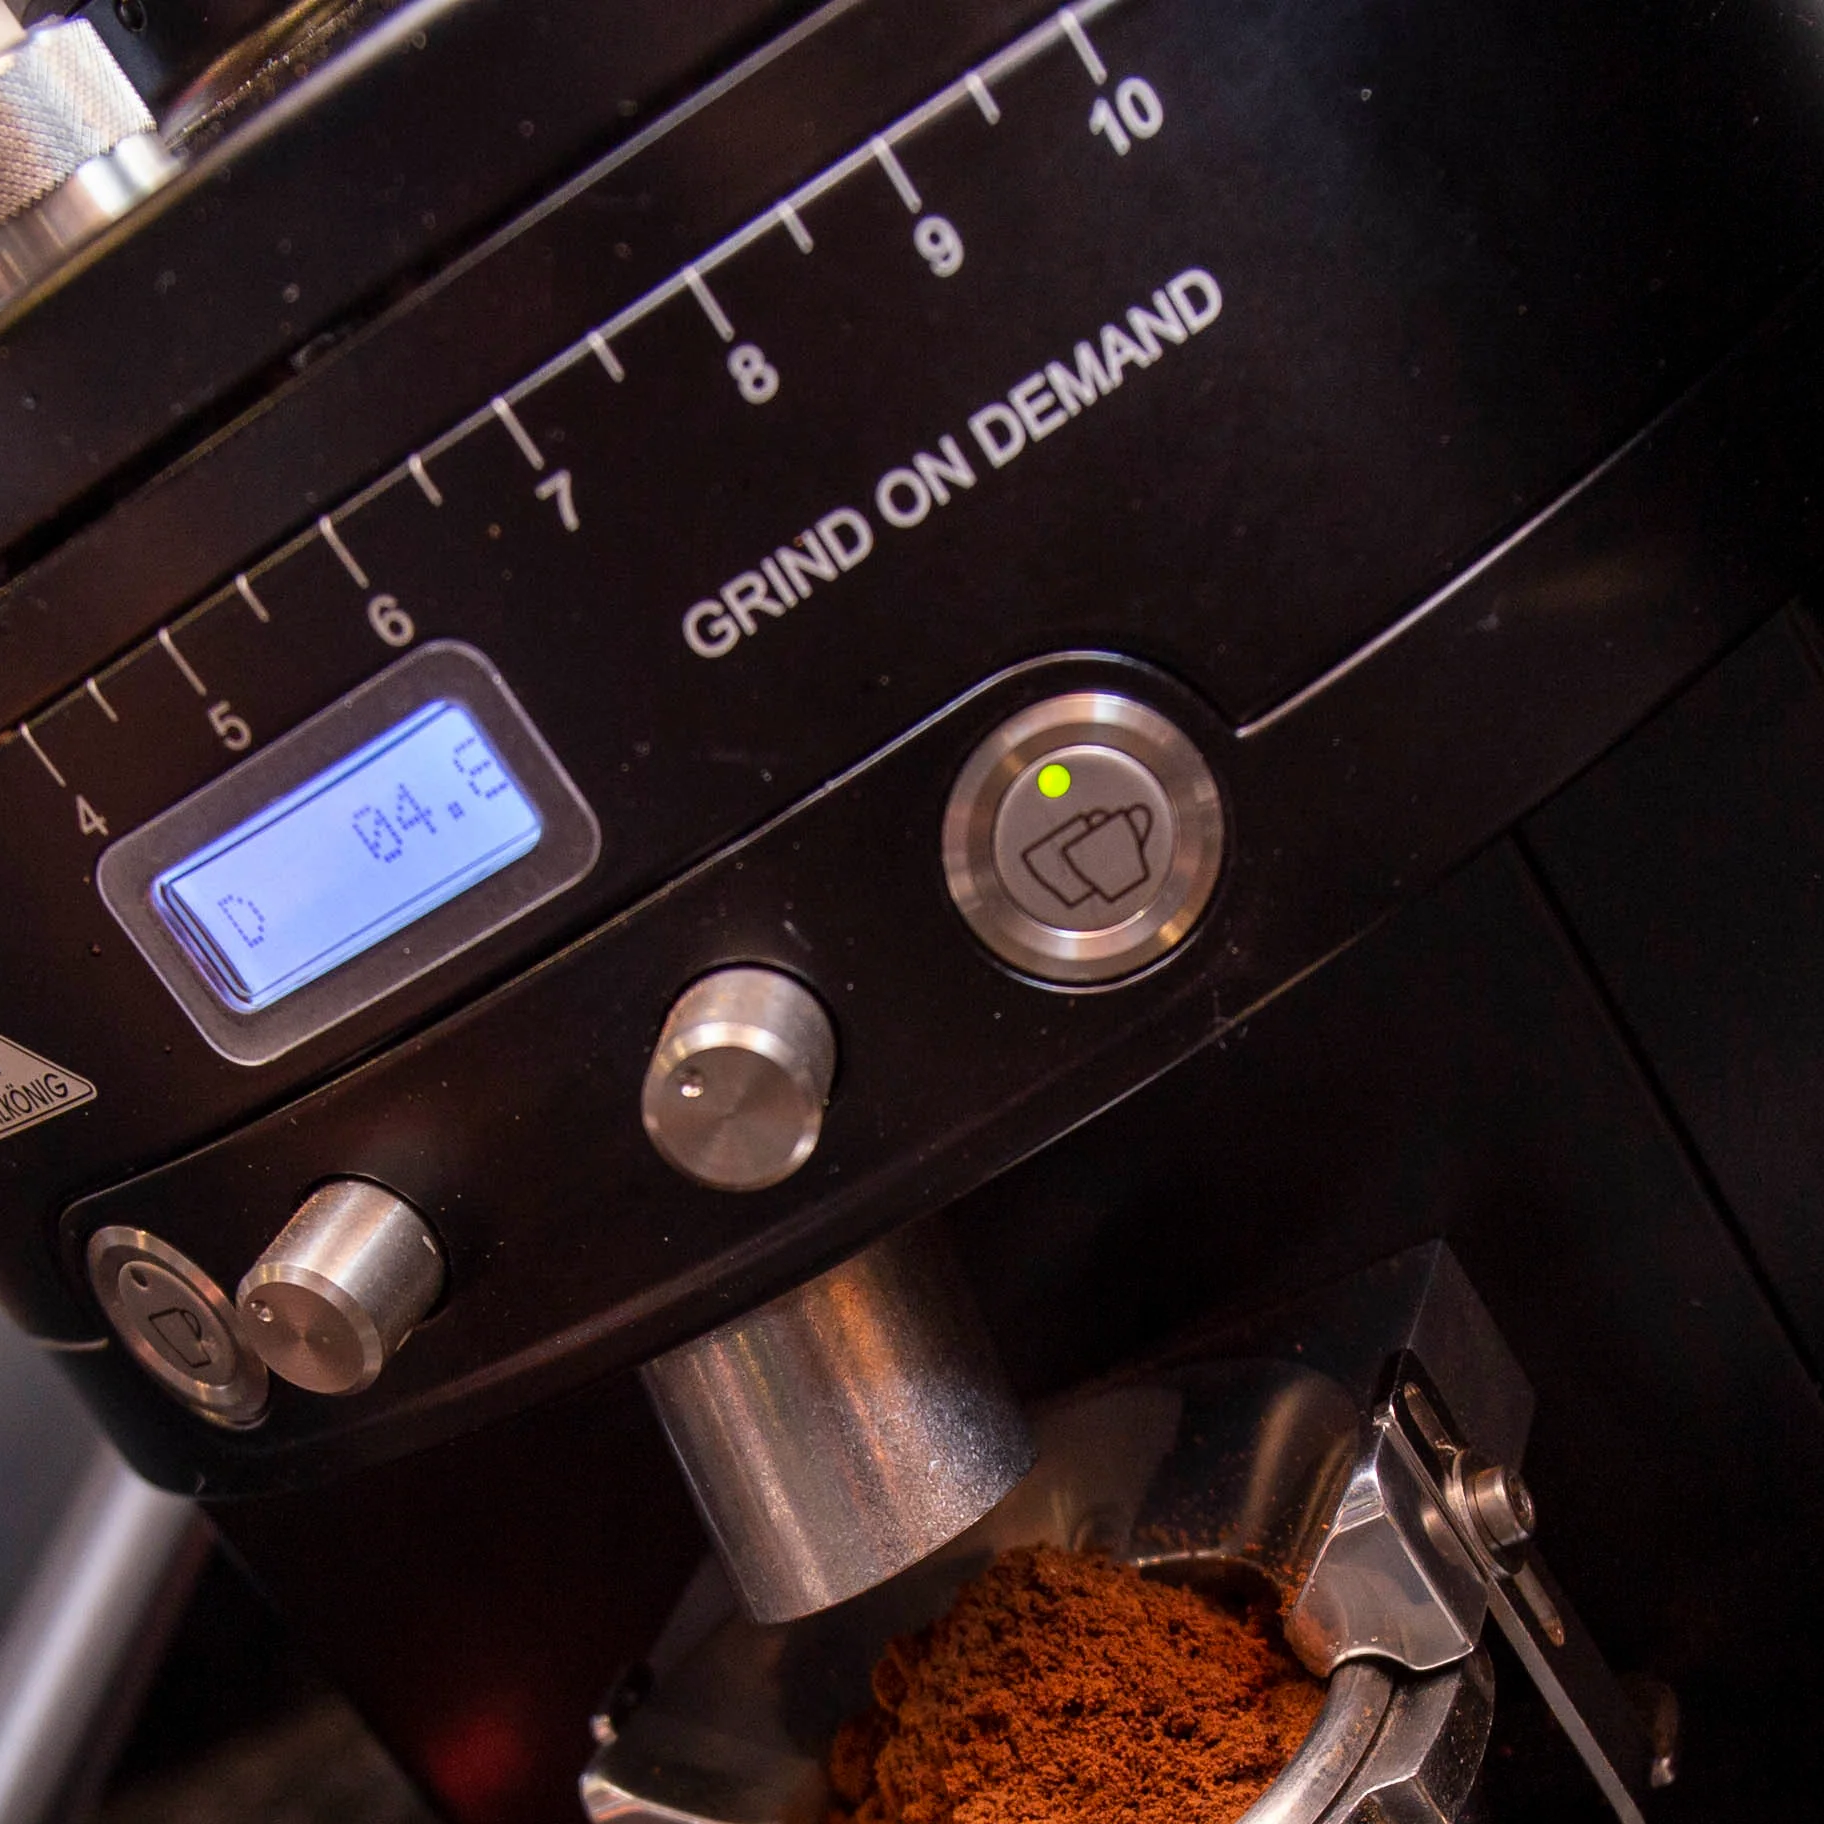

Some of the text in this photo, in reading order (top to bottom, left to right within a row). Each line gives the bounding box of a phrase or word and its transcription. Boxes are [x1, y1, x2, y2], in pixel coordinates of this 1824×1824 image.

[76, 795, 109, 836] 4
[207, 700, 252, 751] 5
[367, 594, 415, 647] 6
[535, 469, 579, 532] 7
[728, 344, 779, 404] 8
[914, 216, 964, 278] 9
[1089, 77, 1164, 156] 10
[682, 268, 1223, 658] GRIND ON DEMAND
[217, 893, 265, 949] D
